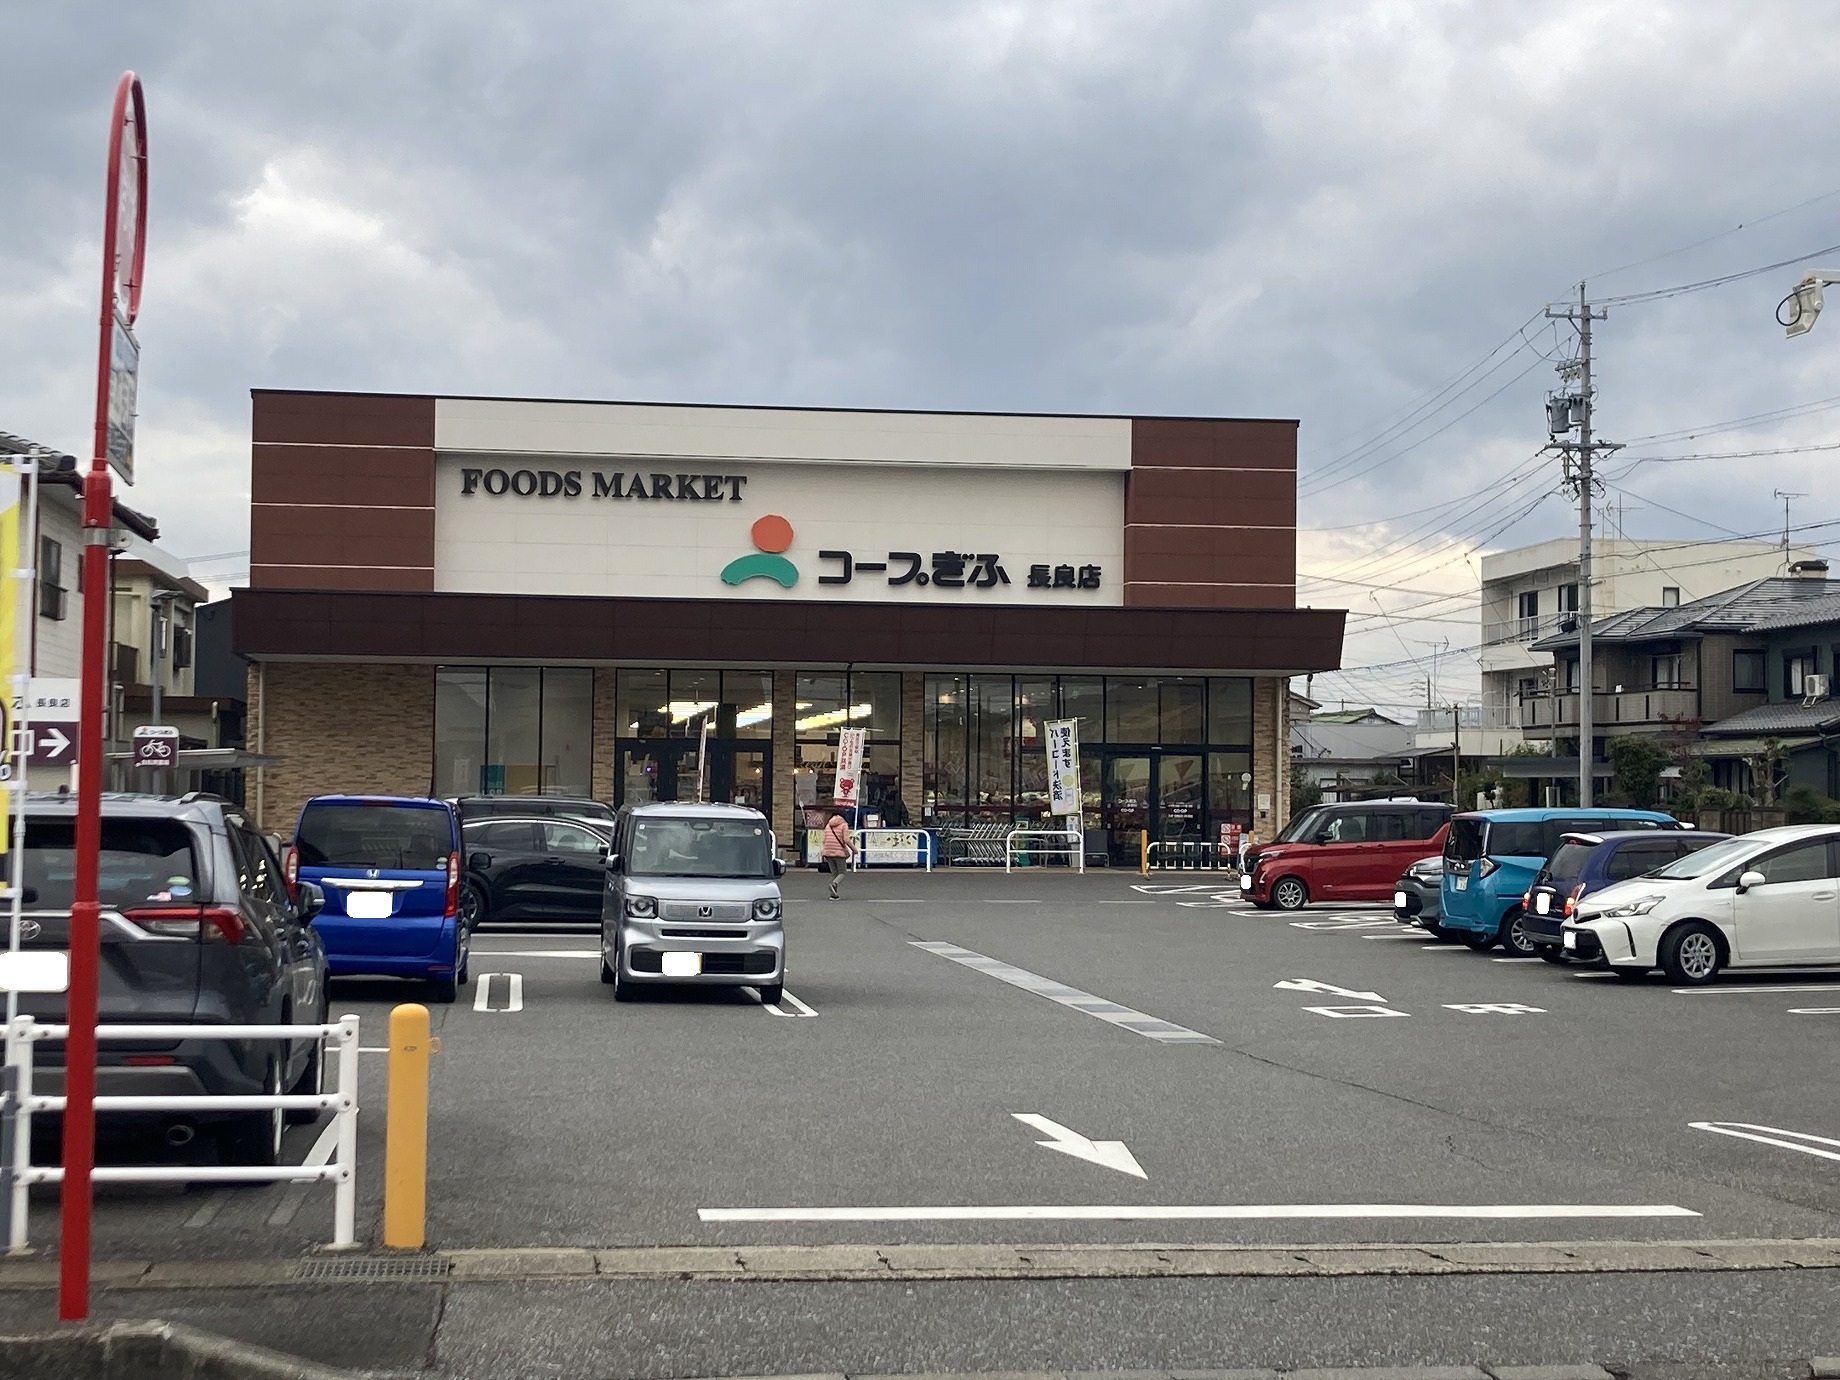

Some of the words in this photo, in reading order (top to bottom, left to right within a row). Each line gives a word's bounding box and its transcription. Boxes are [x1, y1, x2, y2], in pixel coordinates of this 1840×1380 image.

[461, 468, 582, 498] FOODS
[592, 471, 748, 502] MARKET
[818, 549, 1011, 588] コープぎふ
[1027, 563, 1102, 590] 長良店
